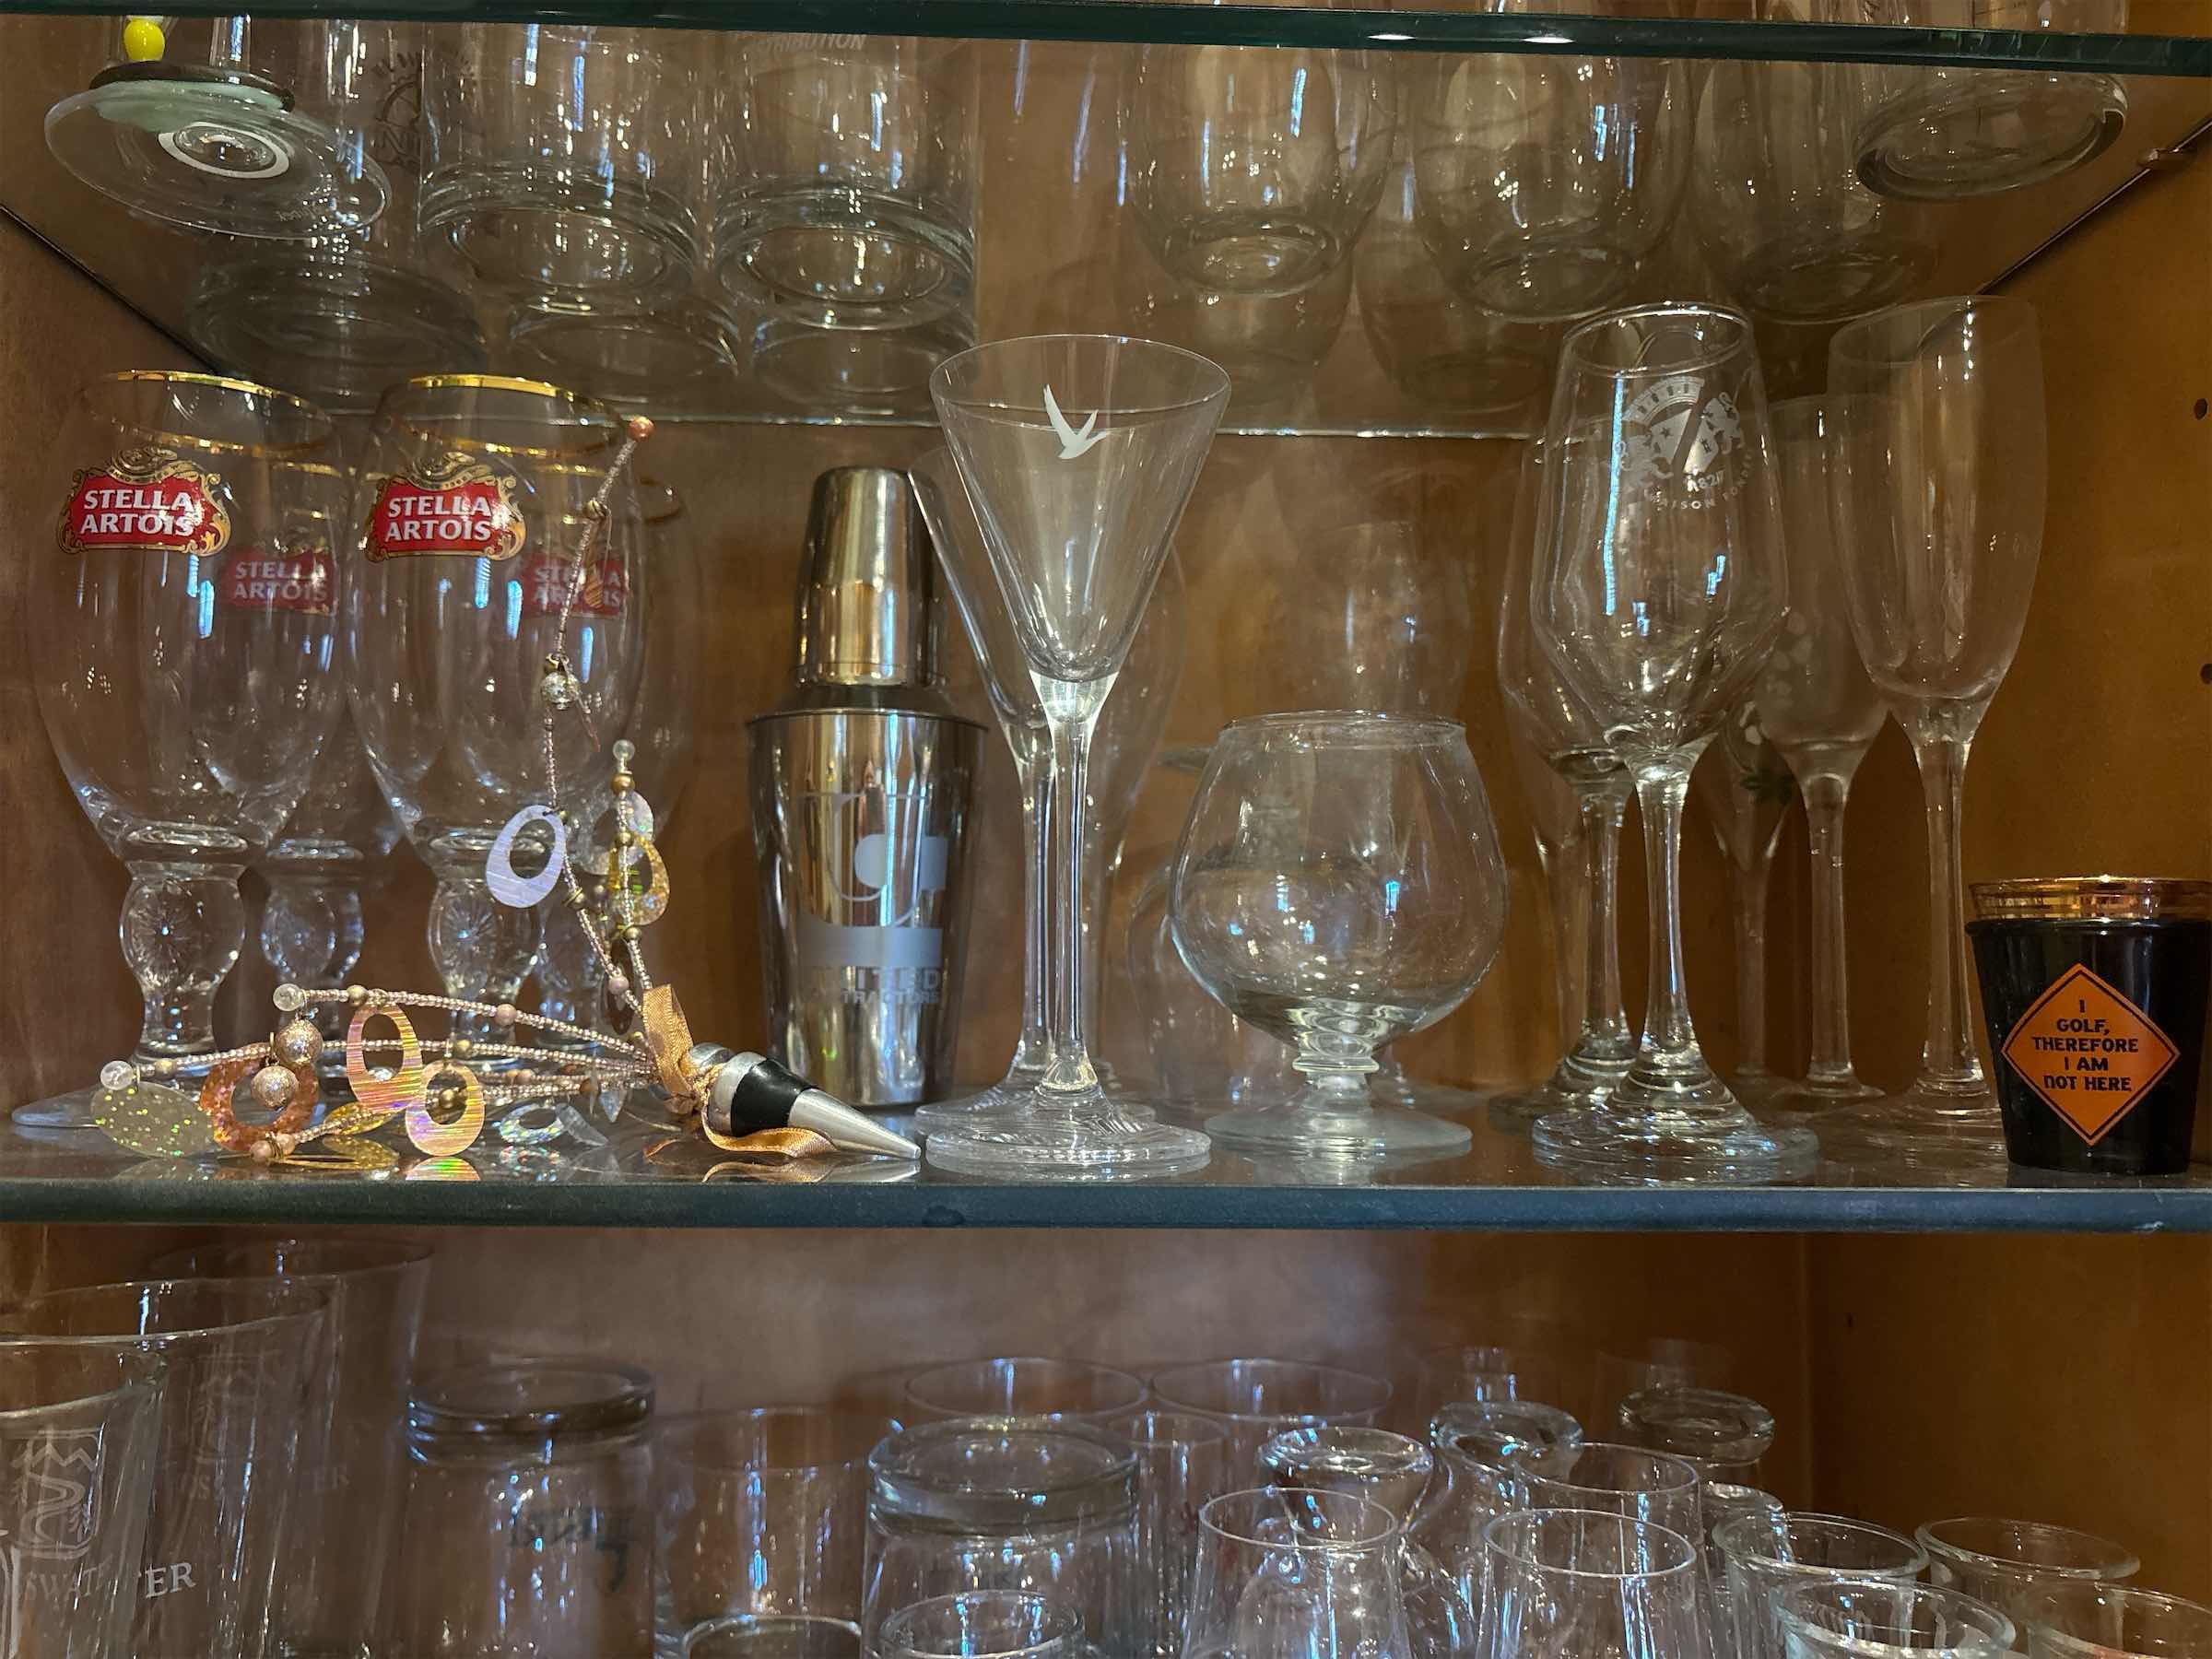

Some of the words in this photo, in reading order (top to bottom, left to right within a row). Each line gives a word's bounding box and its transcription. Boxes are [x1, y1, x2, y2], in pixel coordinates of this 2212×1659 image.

[748, 32, 867, 52] TRIBUTION
[83, 489, 194, 512] STELLA
[387, 496, 492, 518] STELLA
[80, 513, 194, 536] ARTOIS
[385, 520, 492, 542] ARTOIS
[235, 560, 326, 580] STELLA
[235, 582, 326, 602] ARTOIS
[815, 968, 940, 989] ITED
[2079, 999, 2085, 1013] I
[2056, 1018, 2110, 1035] GOLF,
[2031, 1037, 2139, 1053] THEREFORE
[2064, 1056, 2069, 1070] I
[2077, 1057, 2109, 1071] AM
[2084, 1077, 2132, 1091] HERE
